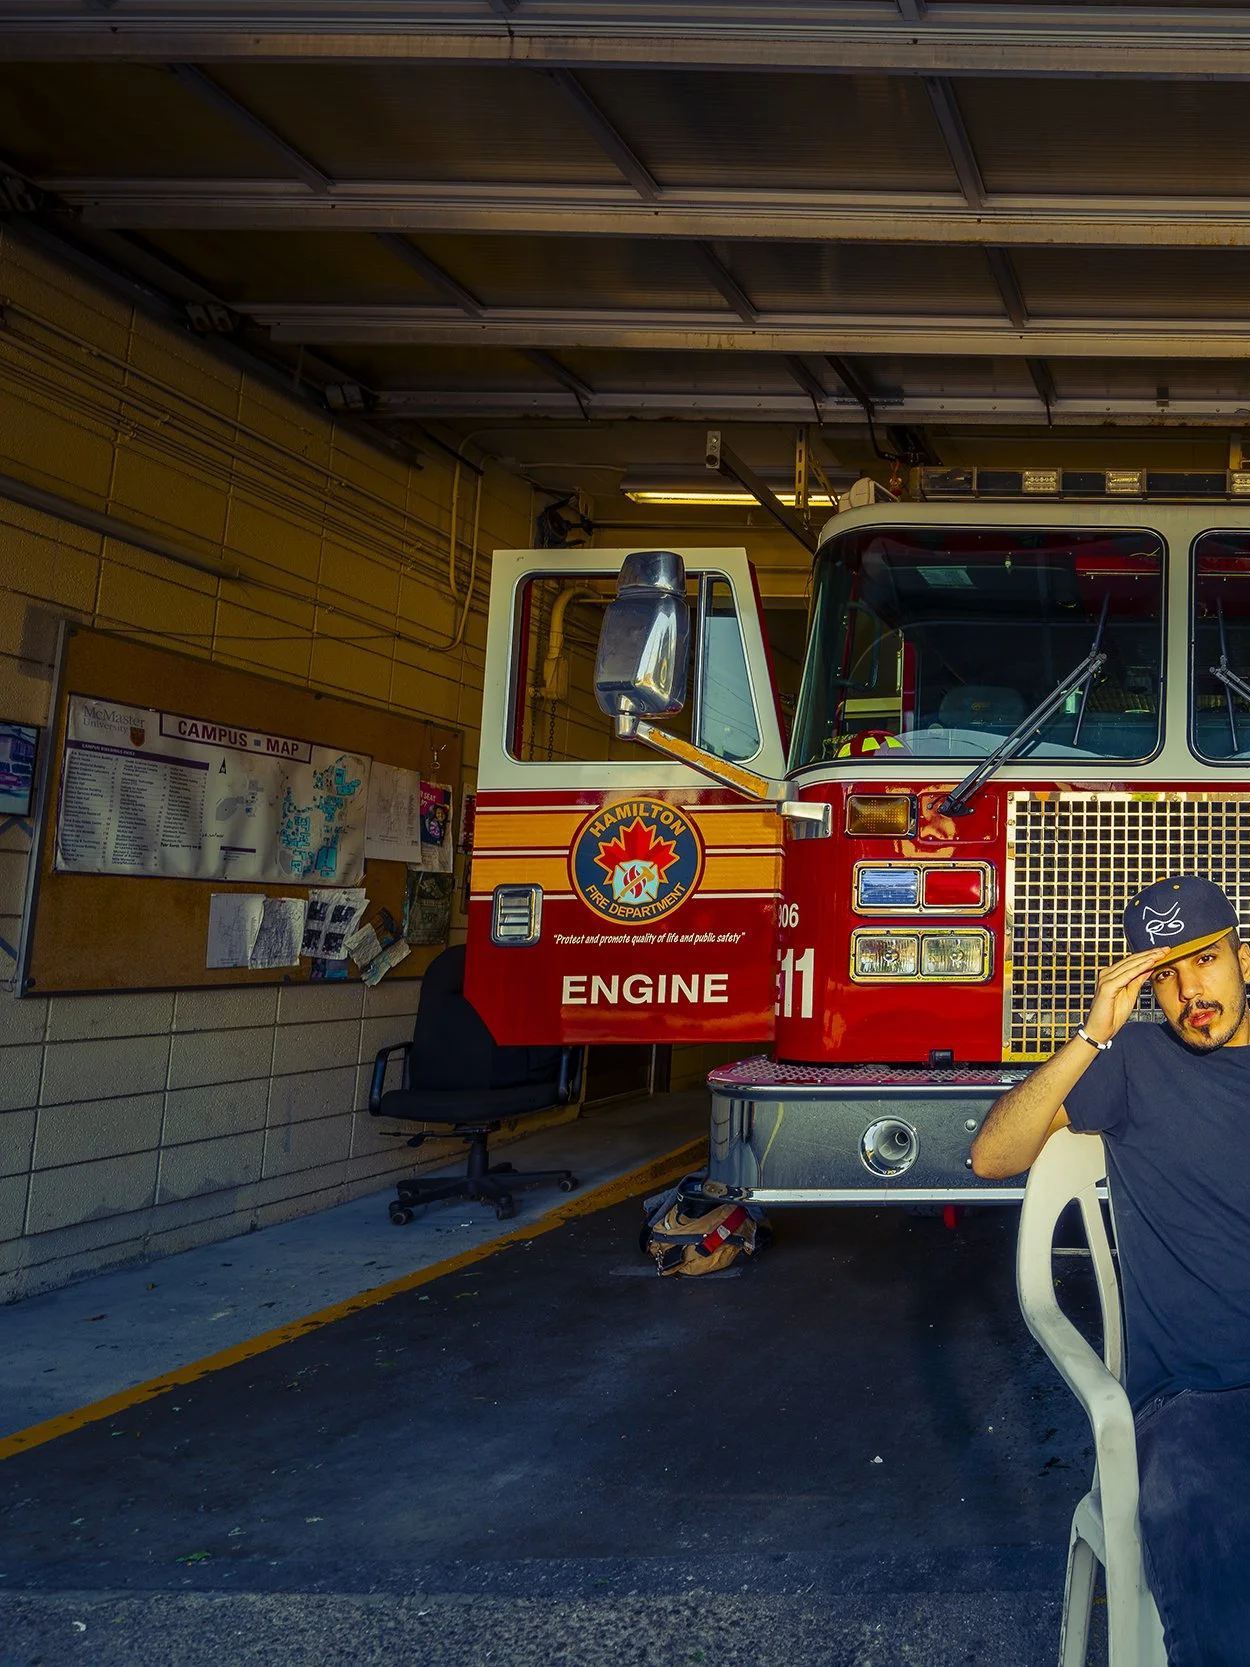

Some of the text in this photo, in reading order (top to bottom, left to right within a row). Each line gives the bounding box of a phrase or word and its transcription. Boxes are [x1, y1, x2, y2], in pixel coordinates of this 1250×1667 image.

[83, 717, 129, 735] University
[84, 705, 145, 728] McMaster
[178, 720, 299, 756] CAMPUS MAP
[589, 803, 687, 838] HAMILTON
[585, 882, 687, 919] FIRE DEPARTMENT
[585, 933, 600, 944] and
[599, 933, 631, 947] promote
[631, 932, 657, 946] quality
[656, 932, 667, 943] of
[666, 932, 679, 943] life
[679, 932, 695, 943] and
[693, 932, 716, 946] public
[562, 973, 729, 1005] ENGINE
